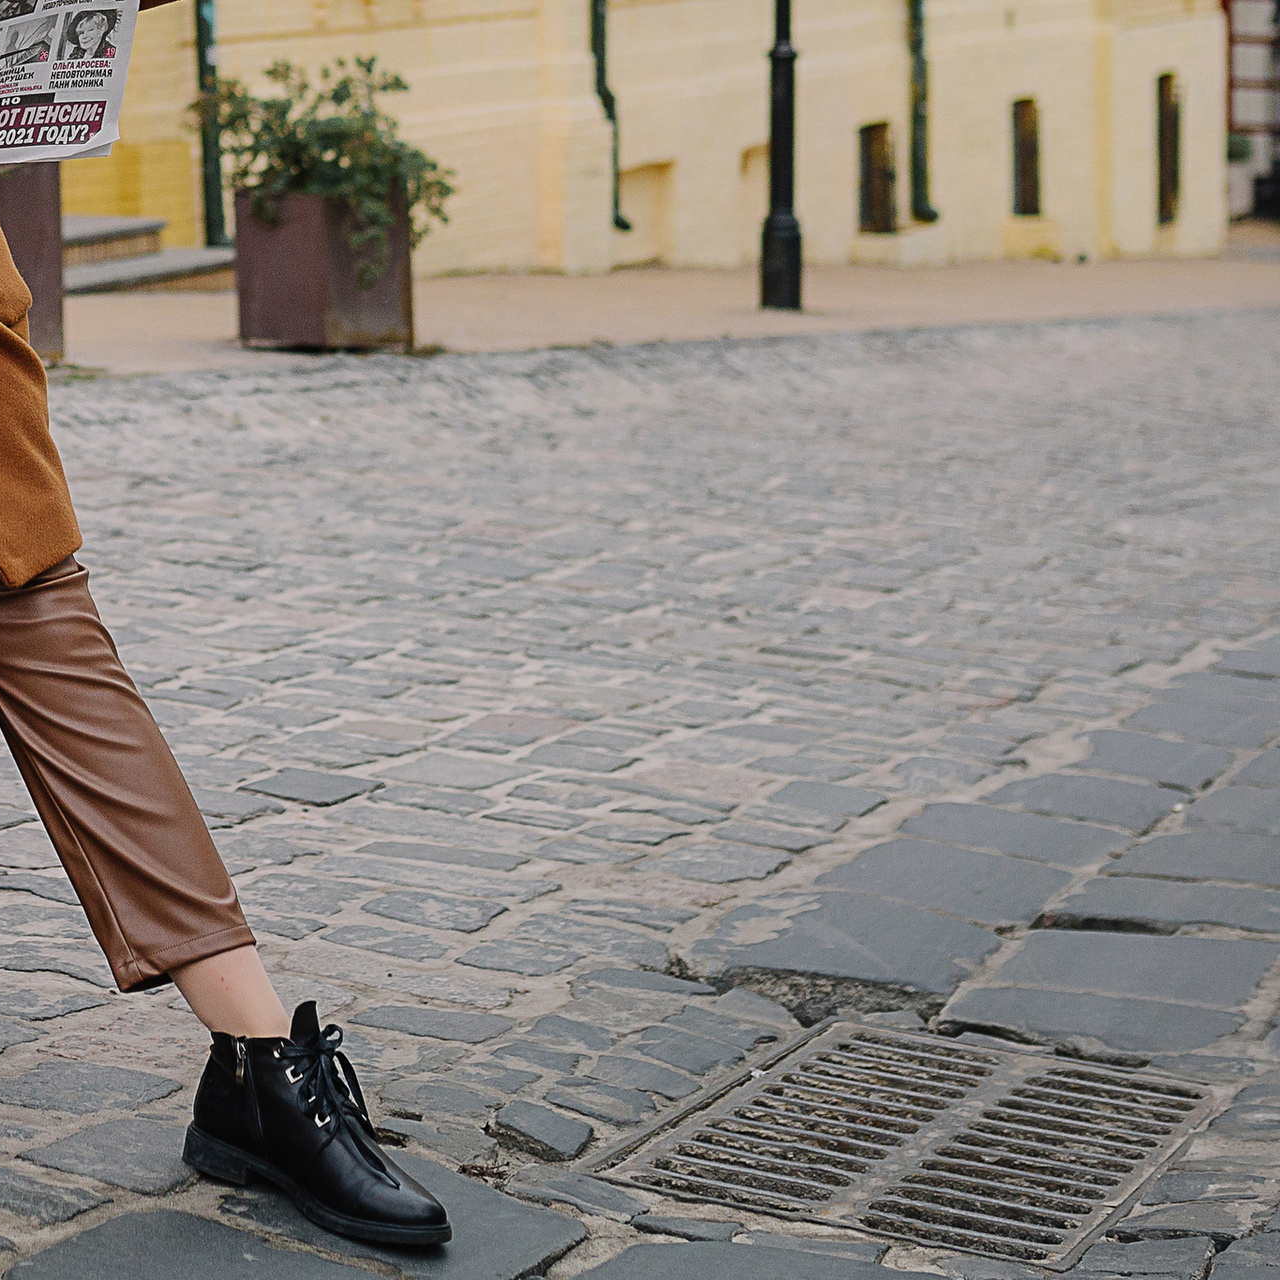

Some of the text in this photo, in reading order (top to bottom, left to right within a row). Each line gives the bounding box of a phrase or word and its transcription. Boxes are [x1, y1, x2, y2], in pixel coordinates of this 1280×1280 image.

[40, 51, 49, 60] 26
[106, 47, 116, 56] 19
[52, 60, 111, 70] ОЛЬГА АРОСЕВА:
[50, 69, 113, 79] НЕПОВТОРИМАЯ
[48, 79, 104, 89] ПАНИ МОНИКА
[21, 104, 103, 127] ПЕНСИИ:
[37, 124, 89, 145] ГОДУ?
